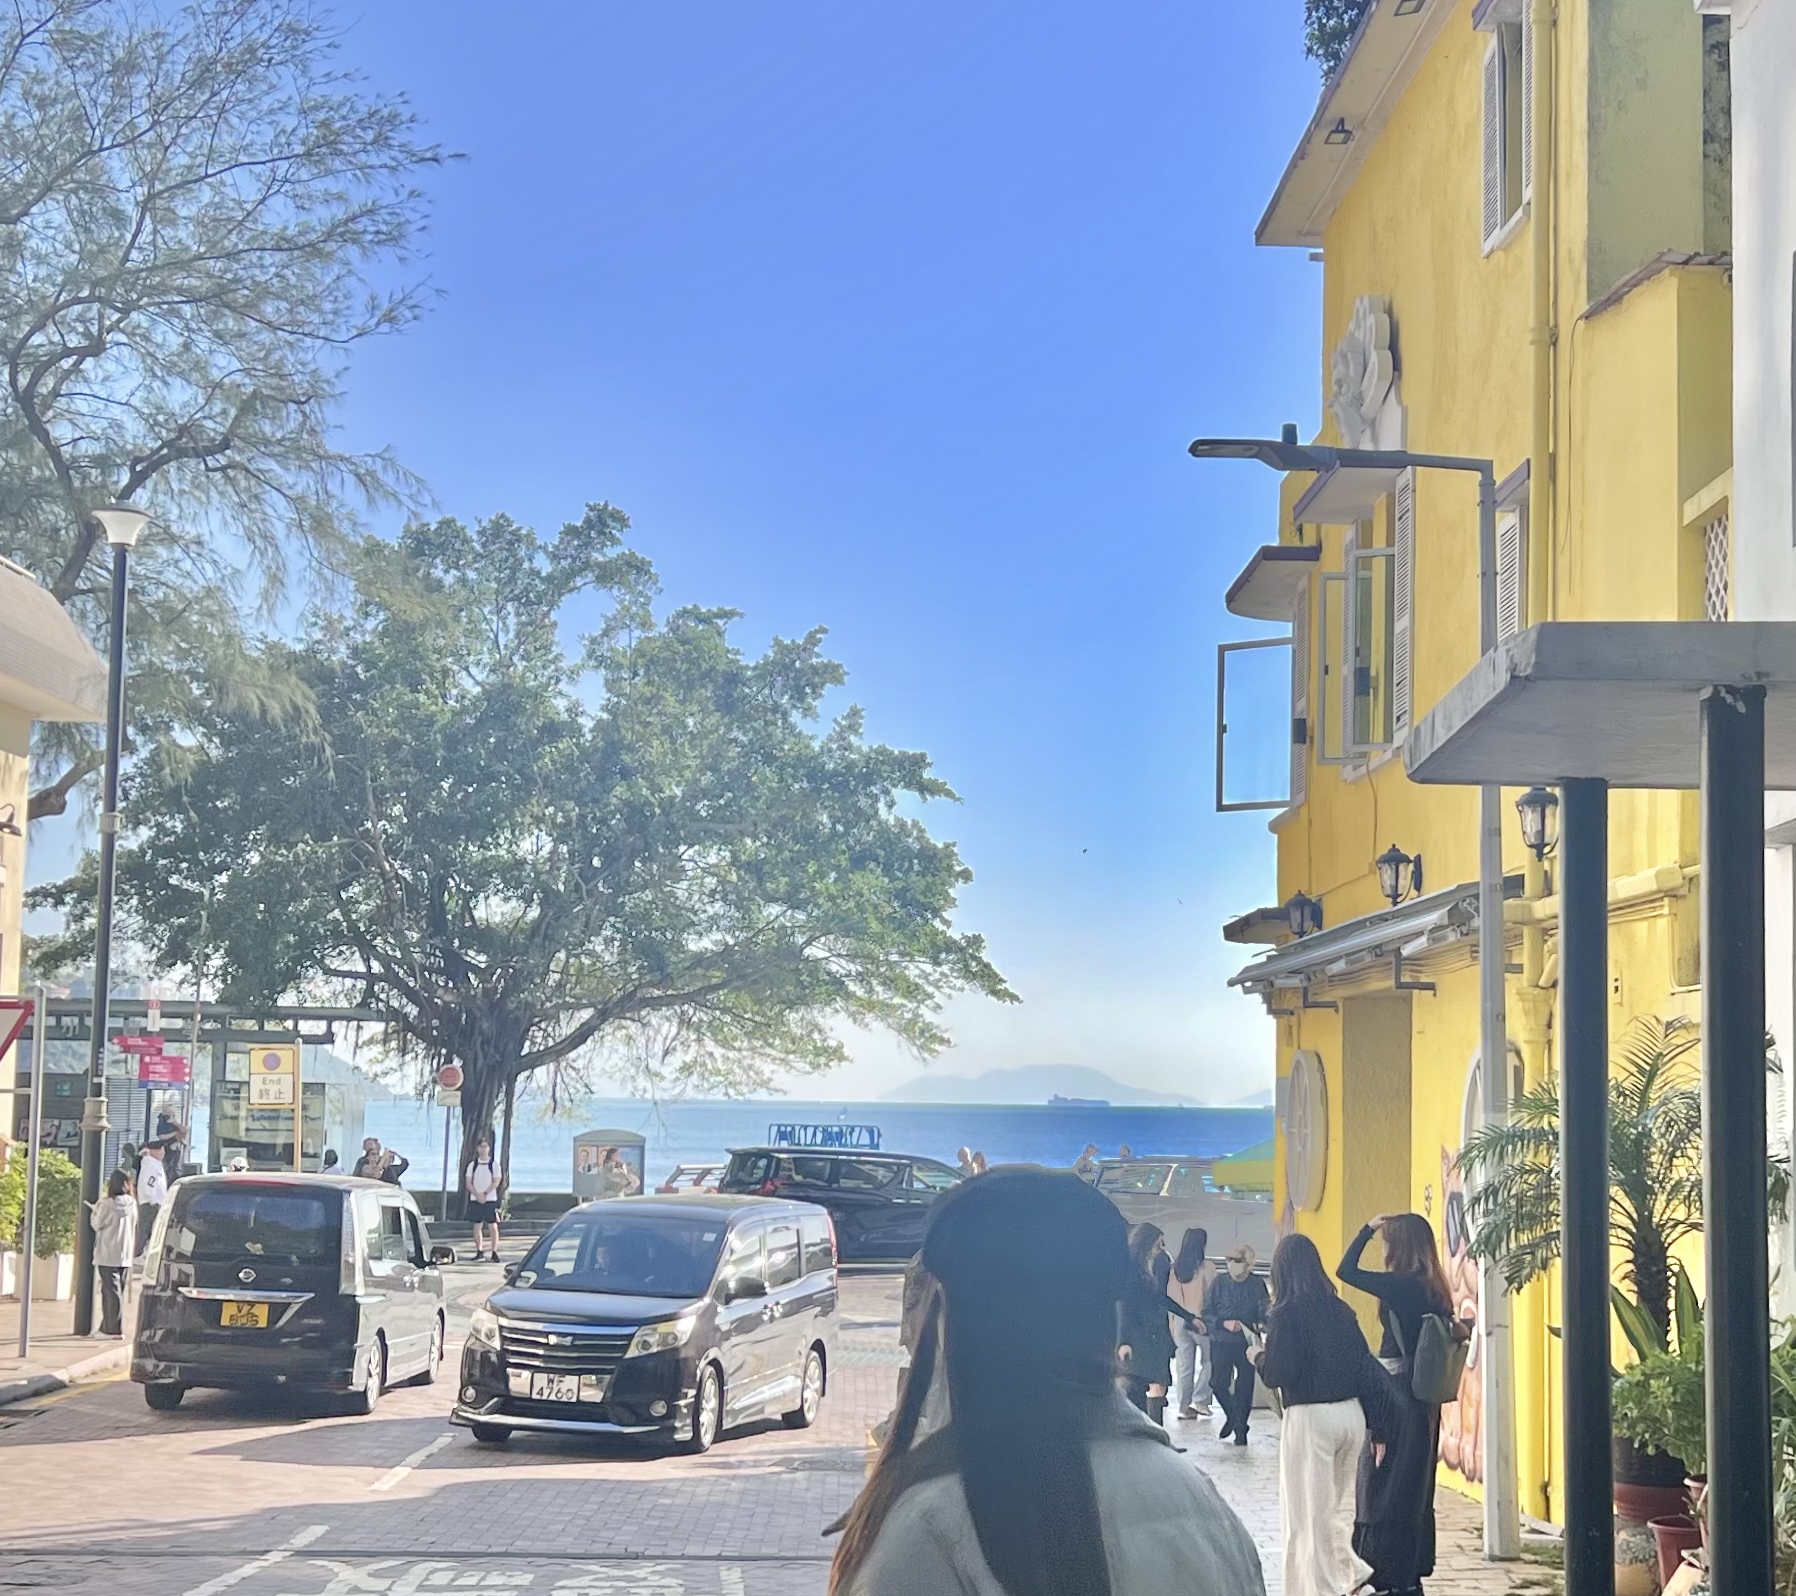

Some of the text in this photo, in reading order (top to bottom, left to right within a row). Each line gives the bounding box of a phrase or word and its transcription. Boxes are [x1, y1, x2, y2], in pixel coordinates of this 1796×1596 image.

[262, 1077, 281, 1086] End
[257, 1088, 286, 1100] 終止
[547, 1373, 566, 1387] WF
[536, 1386, 575, 1400] 4760
